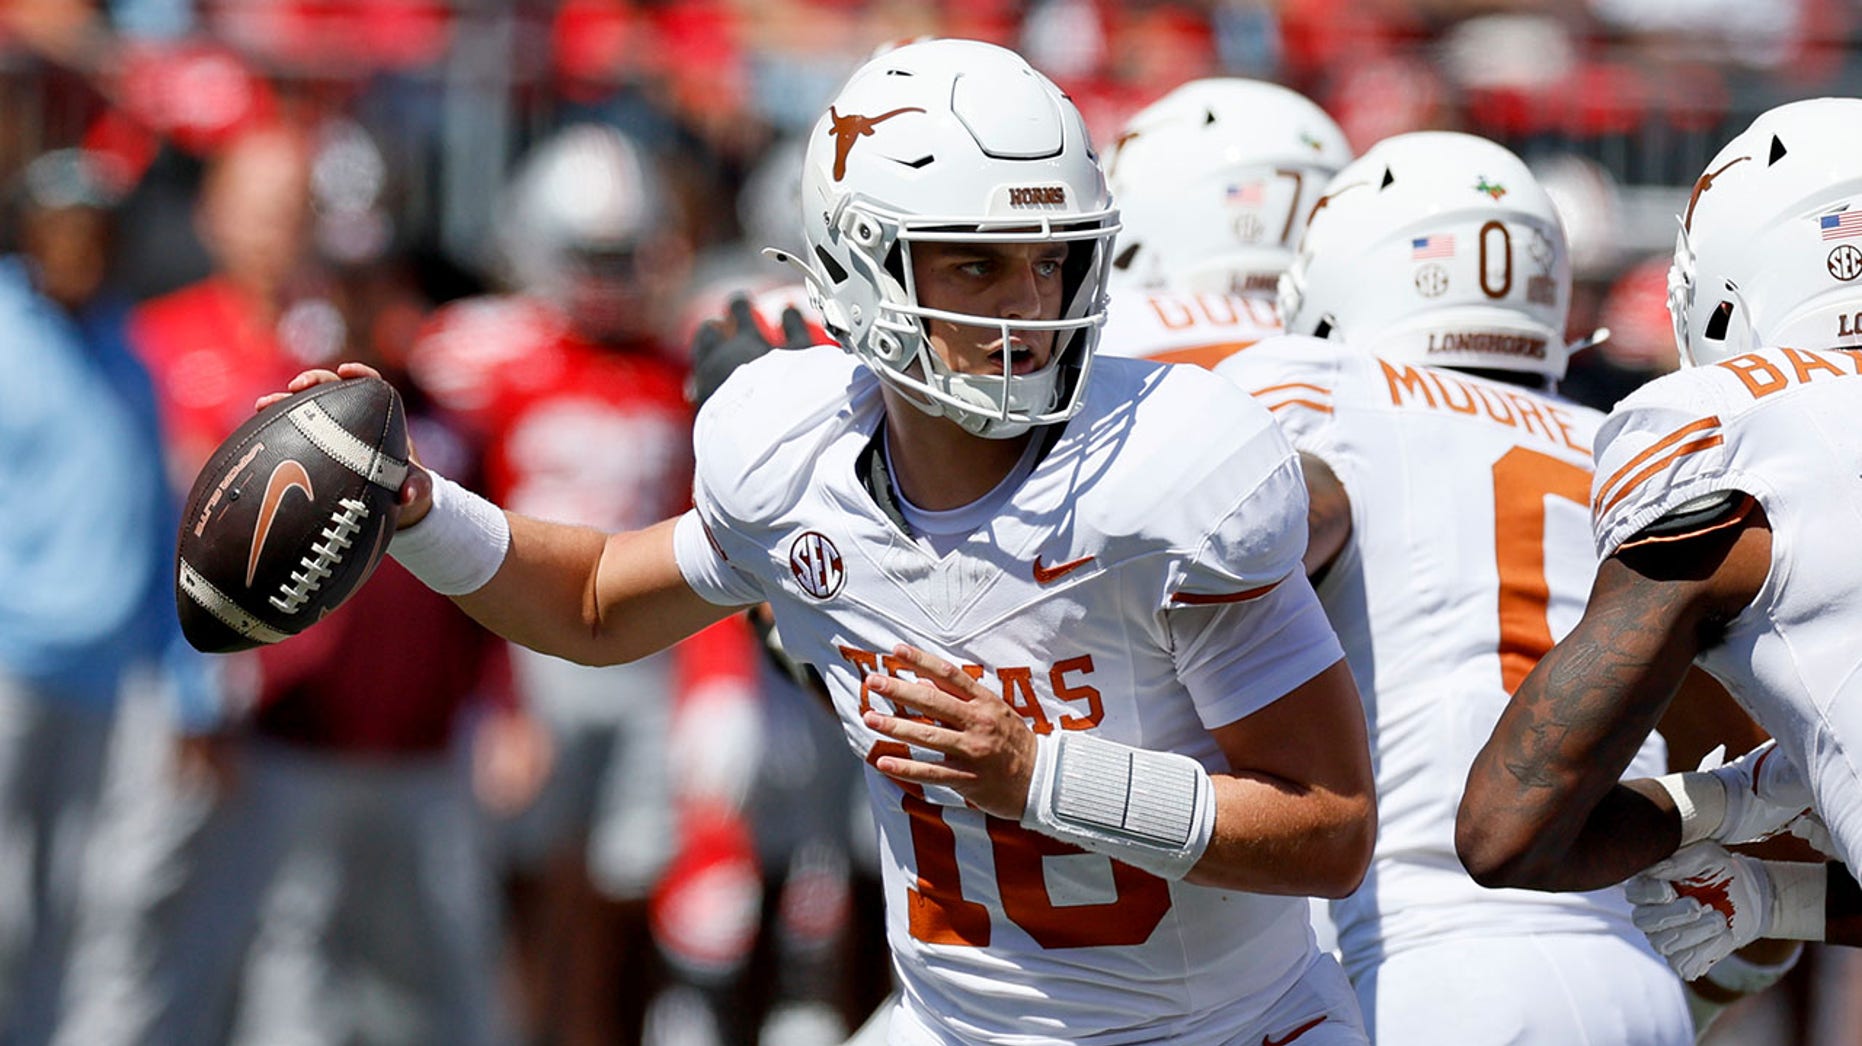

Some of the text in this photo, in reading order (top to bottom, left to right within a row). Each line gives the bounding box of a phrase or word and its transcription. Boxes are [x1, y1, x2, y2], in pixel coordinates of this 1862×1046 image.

[1008, 186, 1065, 207] HORNS
[1479, 220, 1512, 299] 0
[1828, 245, 1862, 281] SEC
[1428, 333, 1548, 361] LONGHORNS
[1377, 358, 1593, 456] MOORE
[789, 531, 845, 600] SEC
[838, 644, 1105, 735] TEAS
